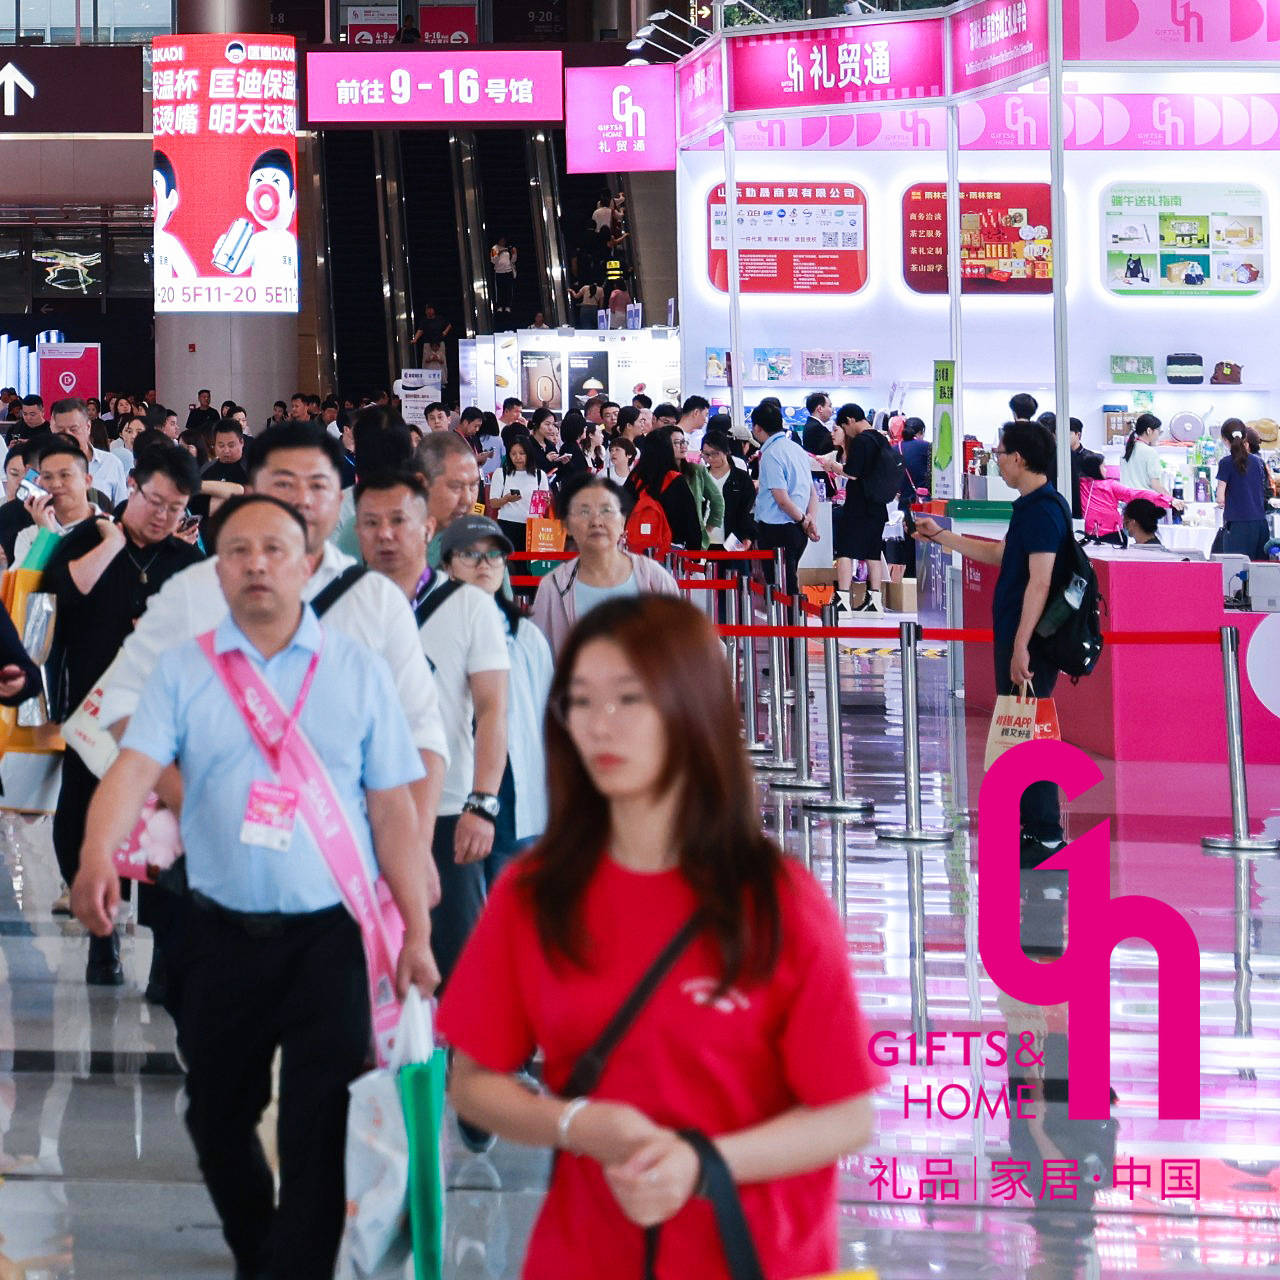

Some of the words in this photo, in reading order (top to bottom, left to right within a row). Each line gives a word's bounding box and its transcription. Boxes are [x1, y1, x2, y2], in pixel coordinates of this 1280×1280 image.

[809, 39, 891, 91] 礼贸通
[598, 140, 646, 153] 礼贸通
[1111, 195, 1182, 207] 端午送礼指南
[181, 286, 257, 304] 5F11-20
